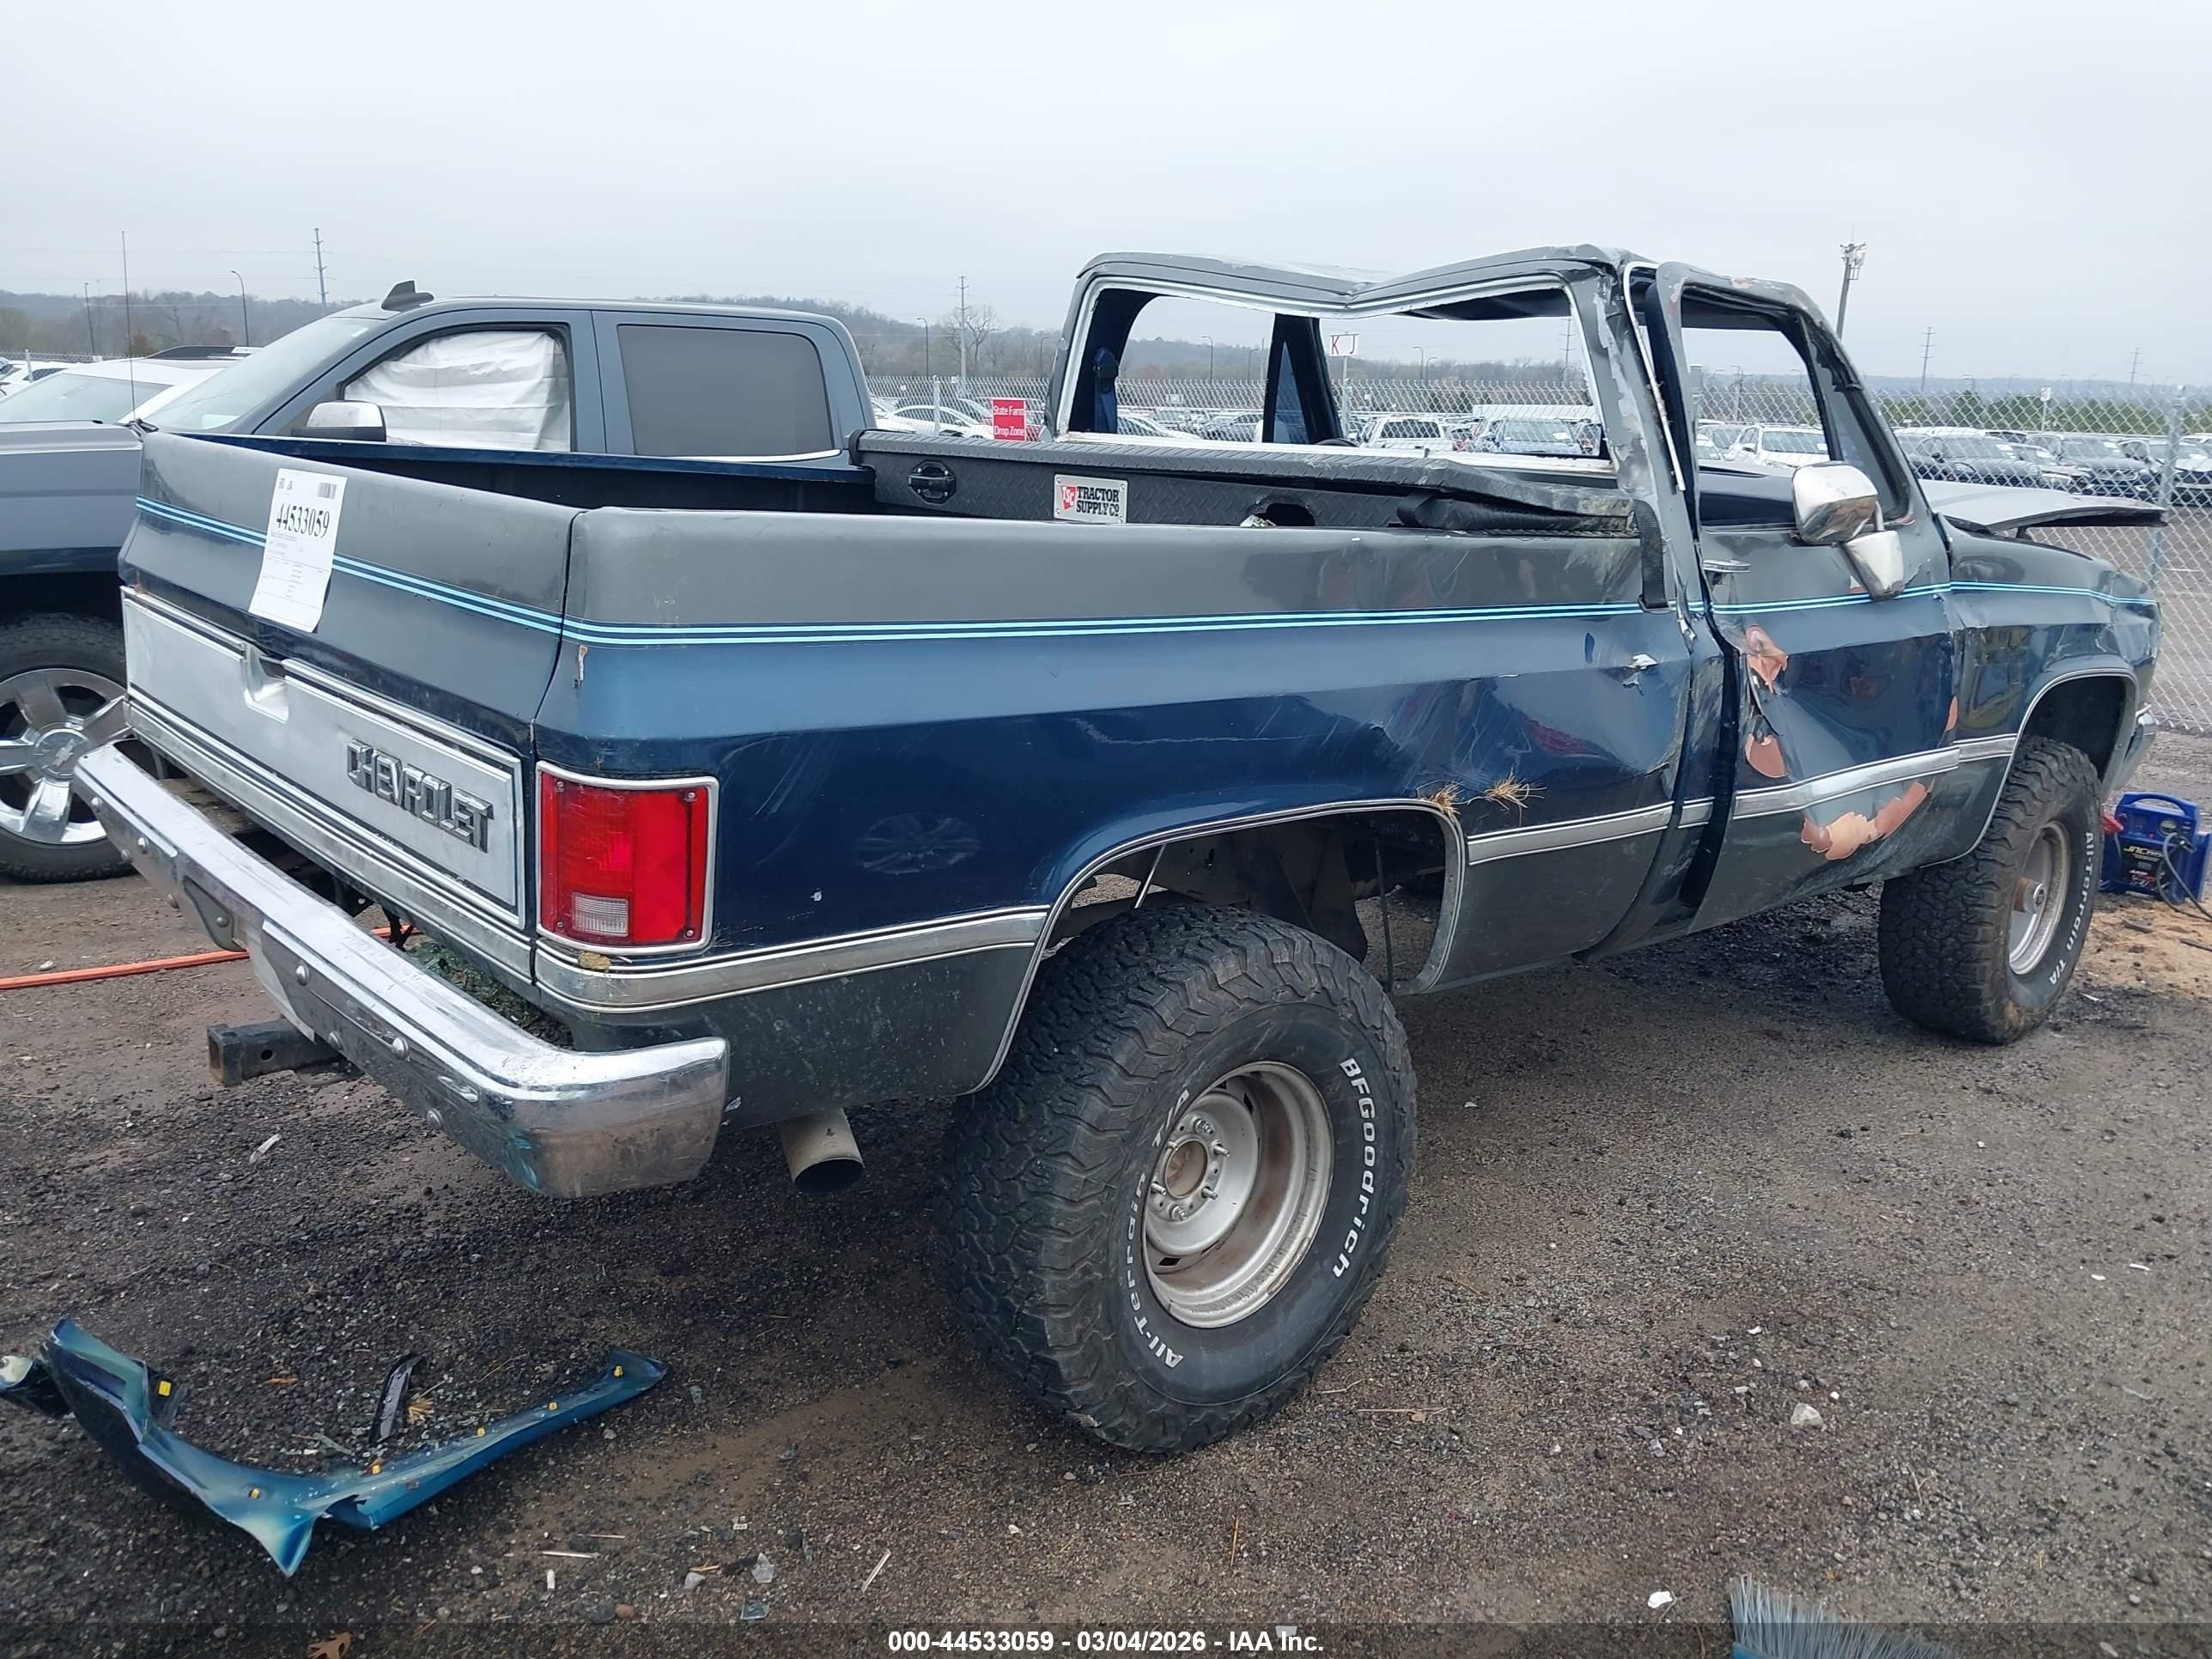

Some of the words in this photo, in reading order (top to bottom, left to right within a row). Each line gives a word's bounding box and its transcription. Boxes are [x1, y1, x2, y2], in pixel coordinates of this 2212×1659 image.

[994, 405, 1009, 416] State
[1009, 405, 1024, 416] Farm
[994, 425, 1009, 438] Drop
[1009, 425, 1024, 436] Zone
[1076, 500, 1109, 516] SUPPLY
[1077, 485, 1120, 503] TRACTOR
[276, 502, 331, 538] 44533059
[346, 738, 495, 854] CHEVROLET
[2048, 958, 2067, 986] T/A
[1151, 1089, 1190, 1148] T/A
[1332, 1057, 1376, 1278] BFGoodrich
[1127, 1173, 1184, 1369] All-Terrain
